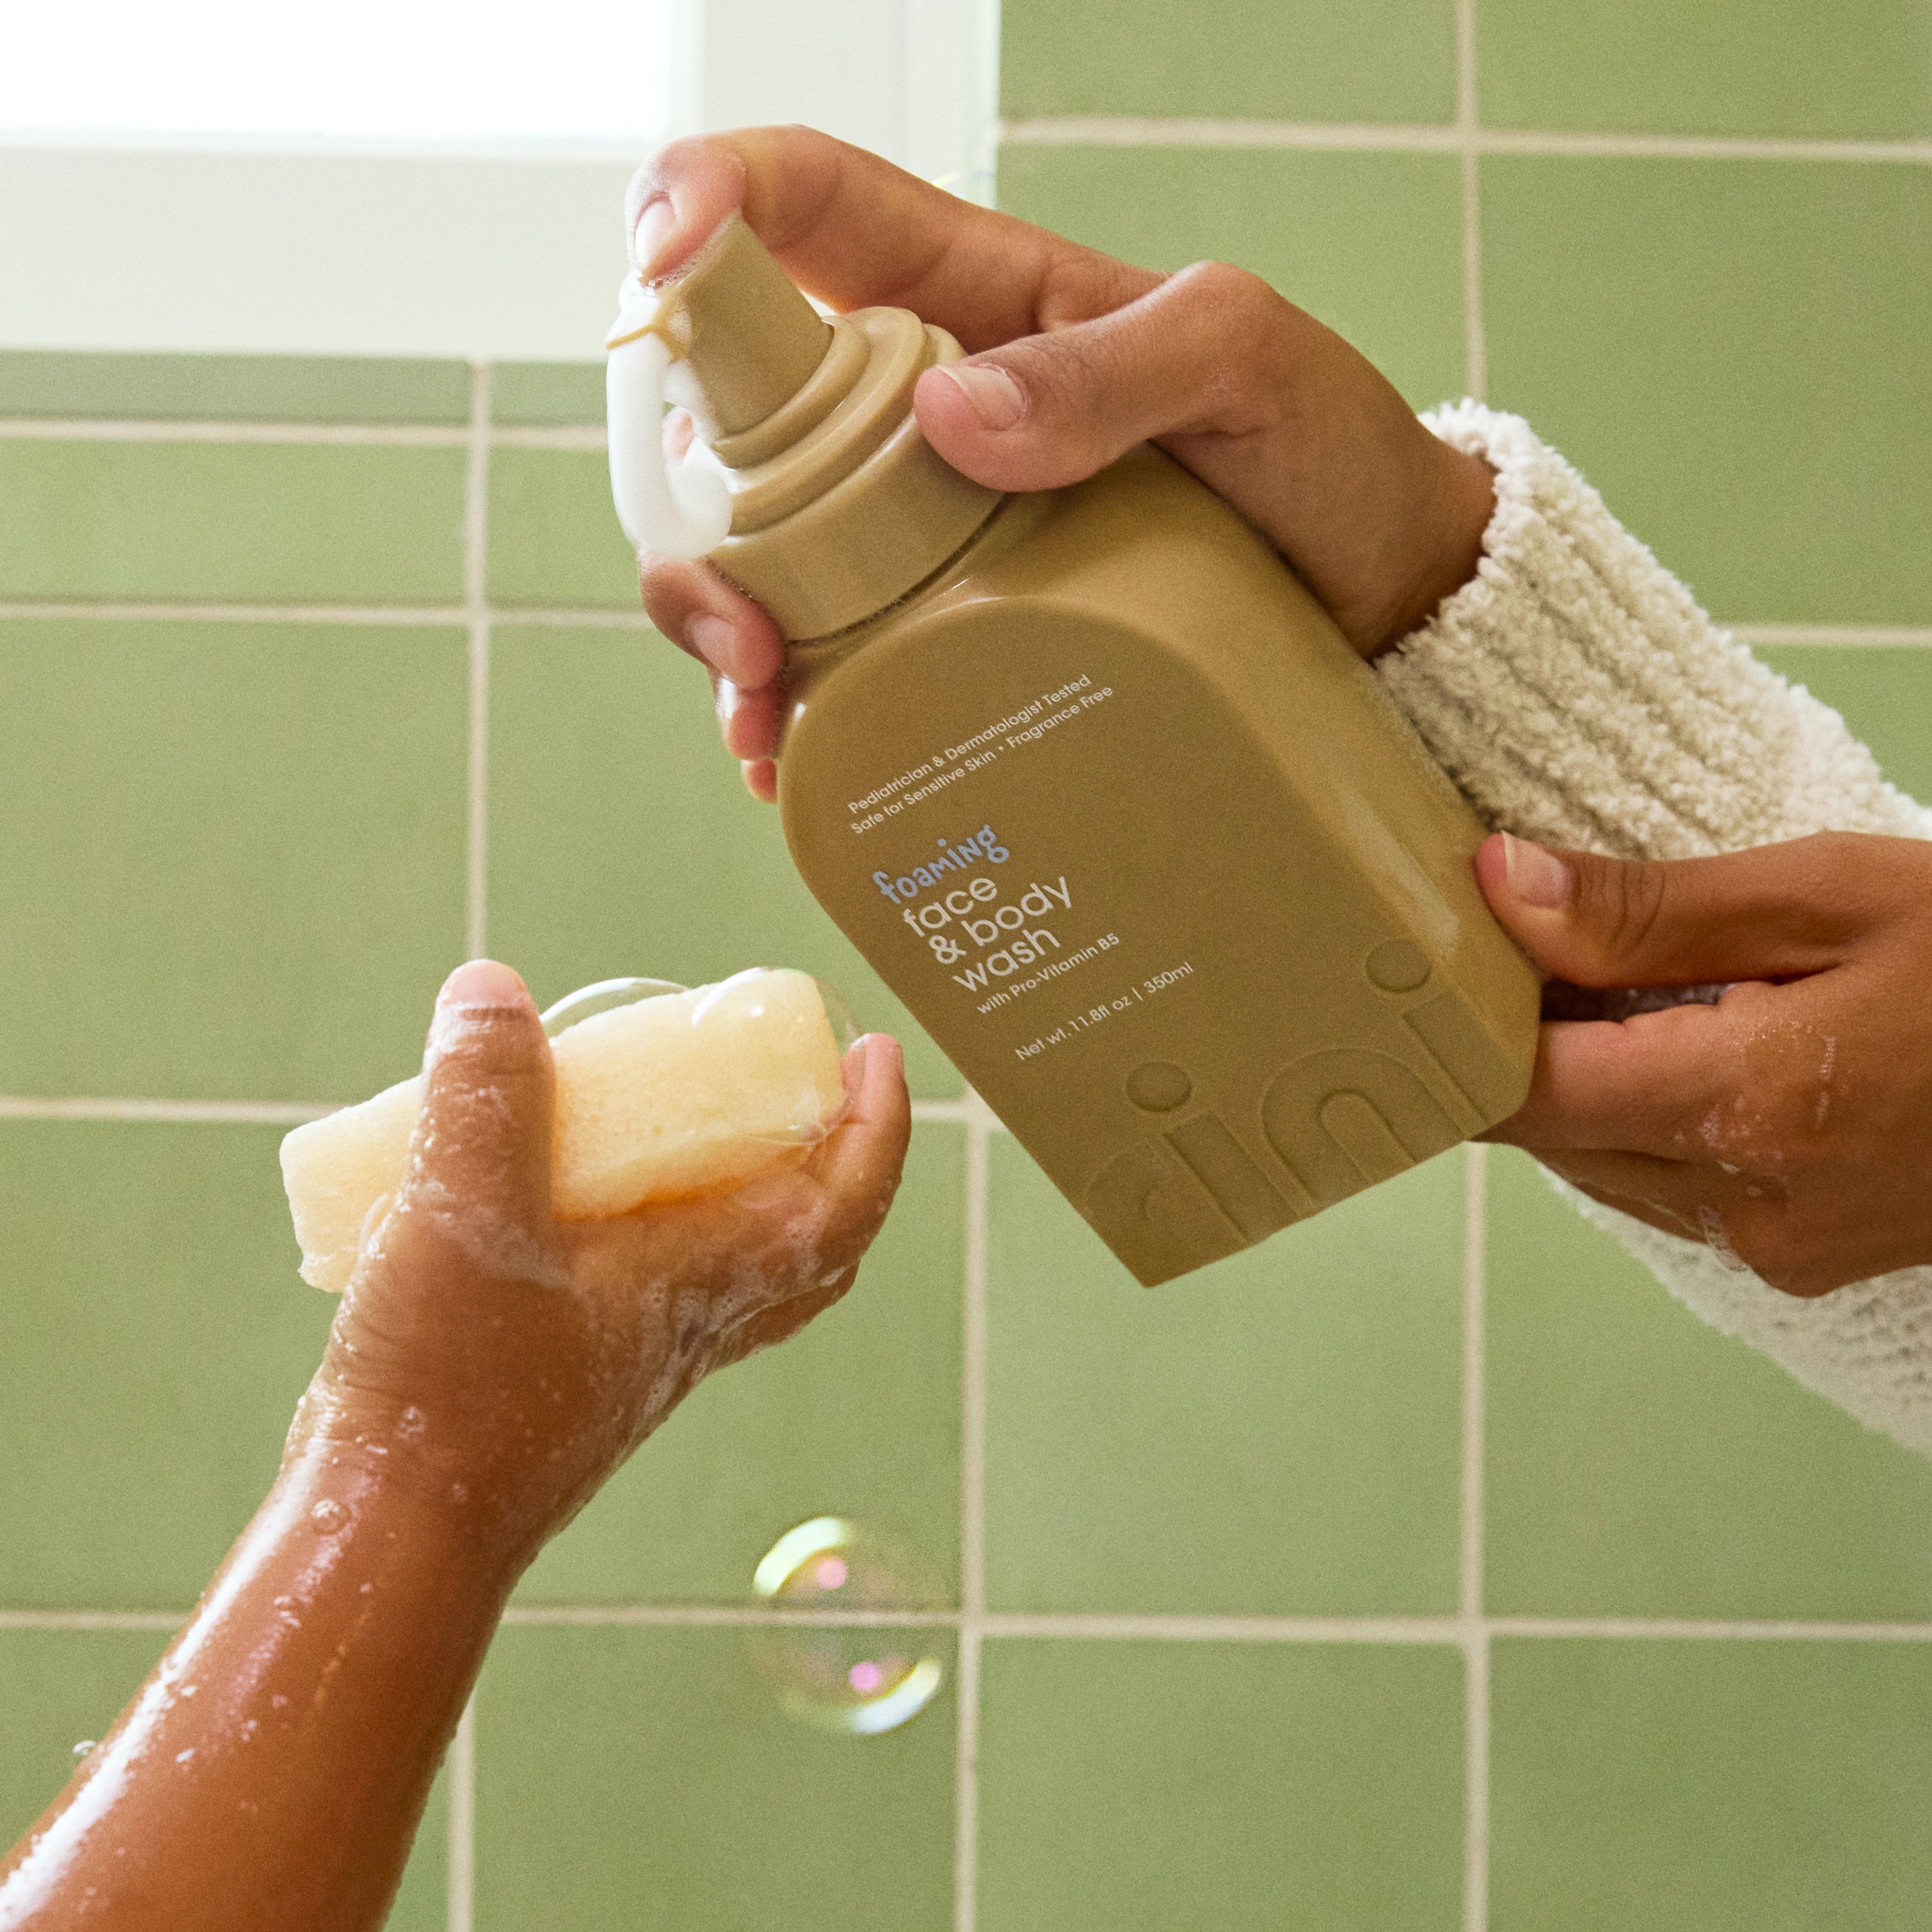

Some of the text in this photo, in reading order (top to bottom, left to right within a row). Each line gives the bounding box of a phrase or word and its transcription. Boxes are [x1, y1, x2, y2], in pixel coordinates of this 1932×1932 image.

[848, 674, 1091, 814] Pediatrician & Dermatologist Tested
[851, 687, 1113, 834] Safe for Sensitive Skin Fragrance Free
[872, 824, 1009, 904] foaming
[903, 878, 997, 937] face
[928, 876, 1072, 964] & body
[952, 929, 1060, 992] wash
[977, 933, 1120, 1013] with Pro-Vitamin B5
[1015, 1039, 1045, 1060] Net
[1112, 996, 1132, 1010] oz
[1144, 961, 1194, 993] 350ml
